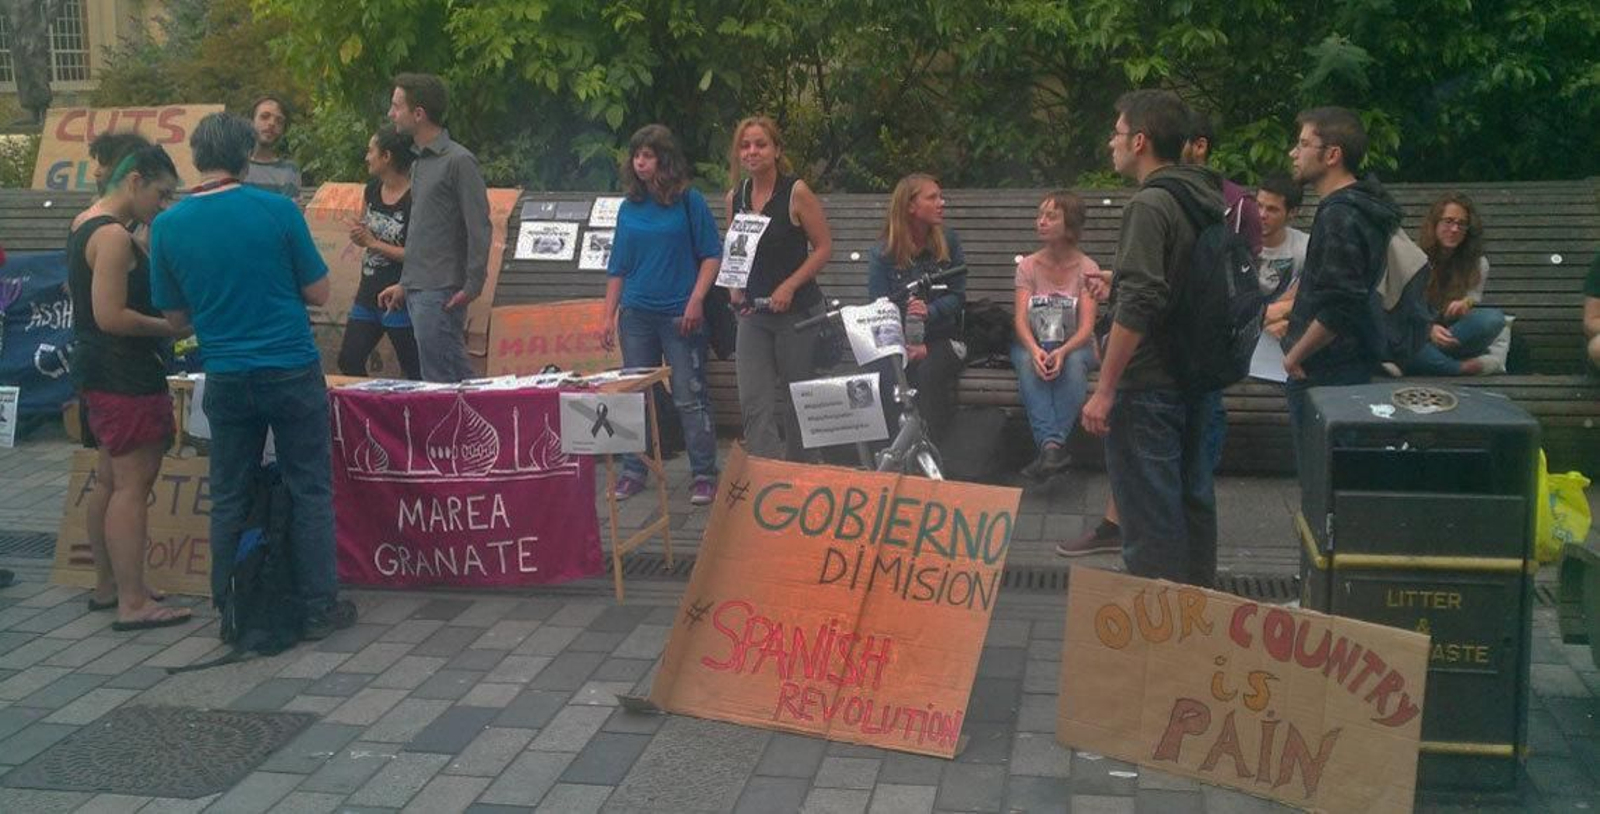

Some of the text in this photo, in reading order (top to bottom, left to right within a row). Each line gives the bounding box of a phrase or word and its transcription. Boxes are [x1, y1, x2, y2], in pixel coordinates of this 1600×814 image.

[55, 107, 186, 144] CUTS
[25, 301, 74, 331] ASSH
[397, 493, 510, 532] MAREA
[374, 536, 538, 576] GRANATE
[1386, 588, 1462, 609] LITTER
[1416, 618, 1429, 635] &
[1094, 585, 1421, 728] OUR COUNTRY
[1433, 643, 1490, 663] ASTE
[1152, 697, 1343, 800] PAIN
